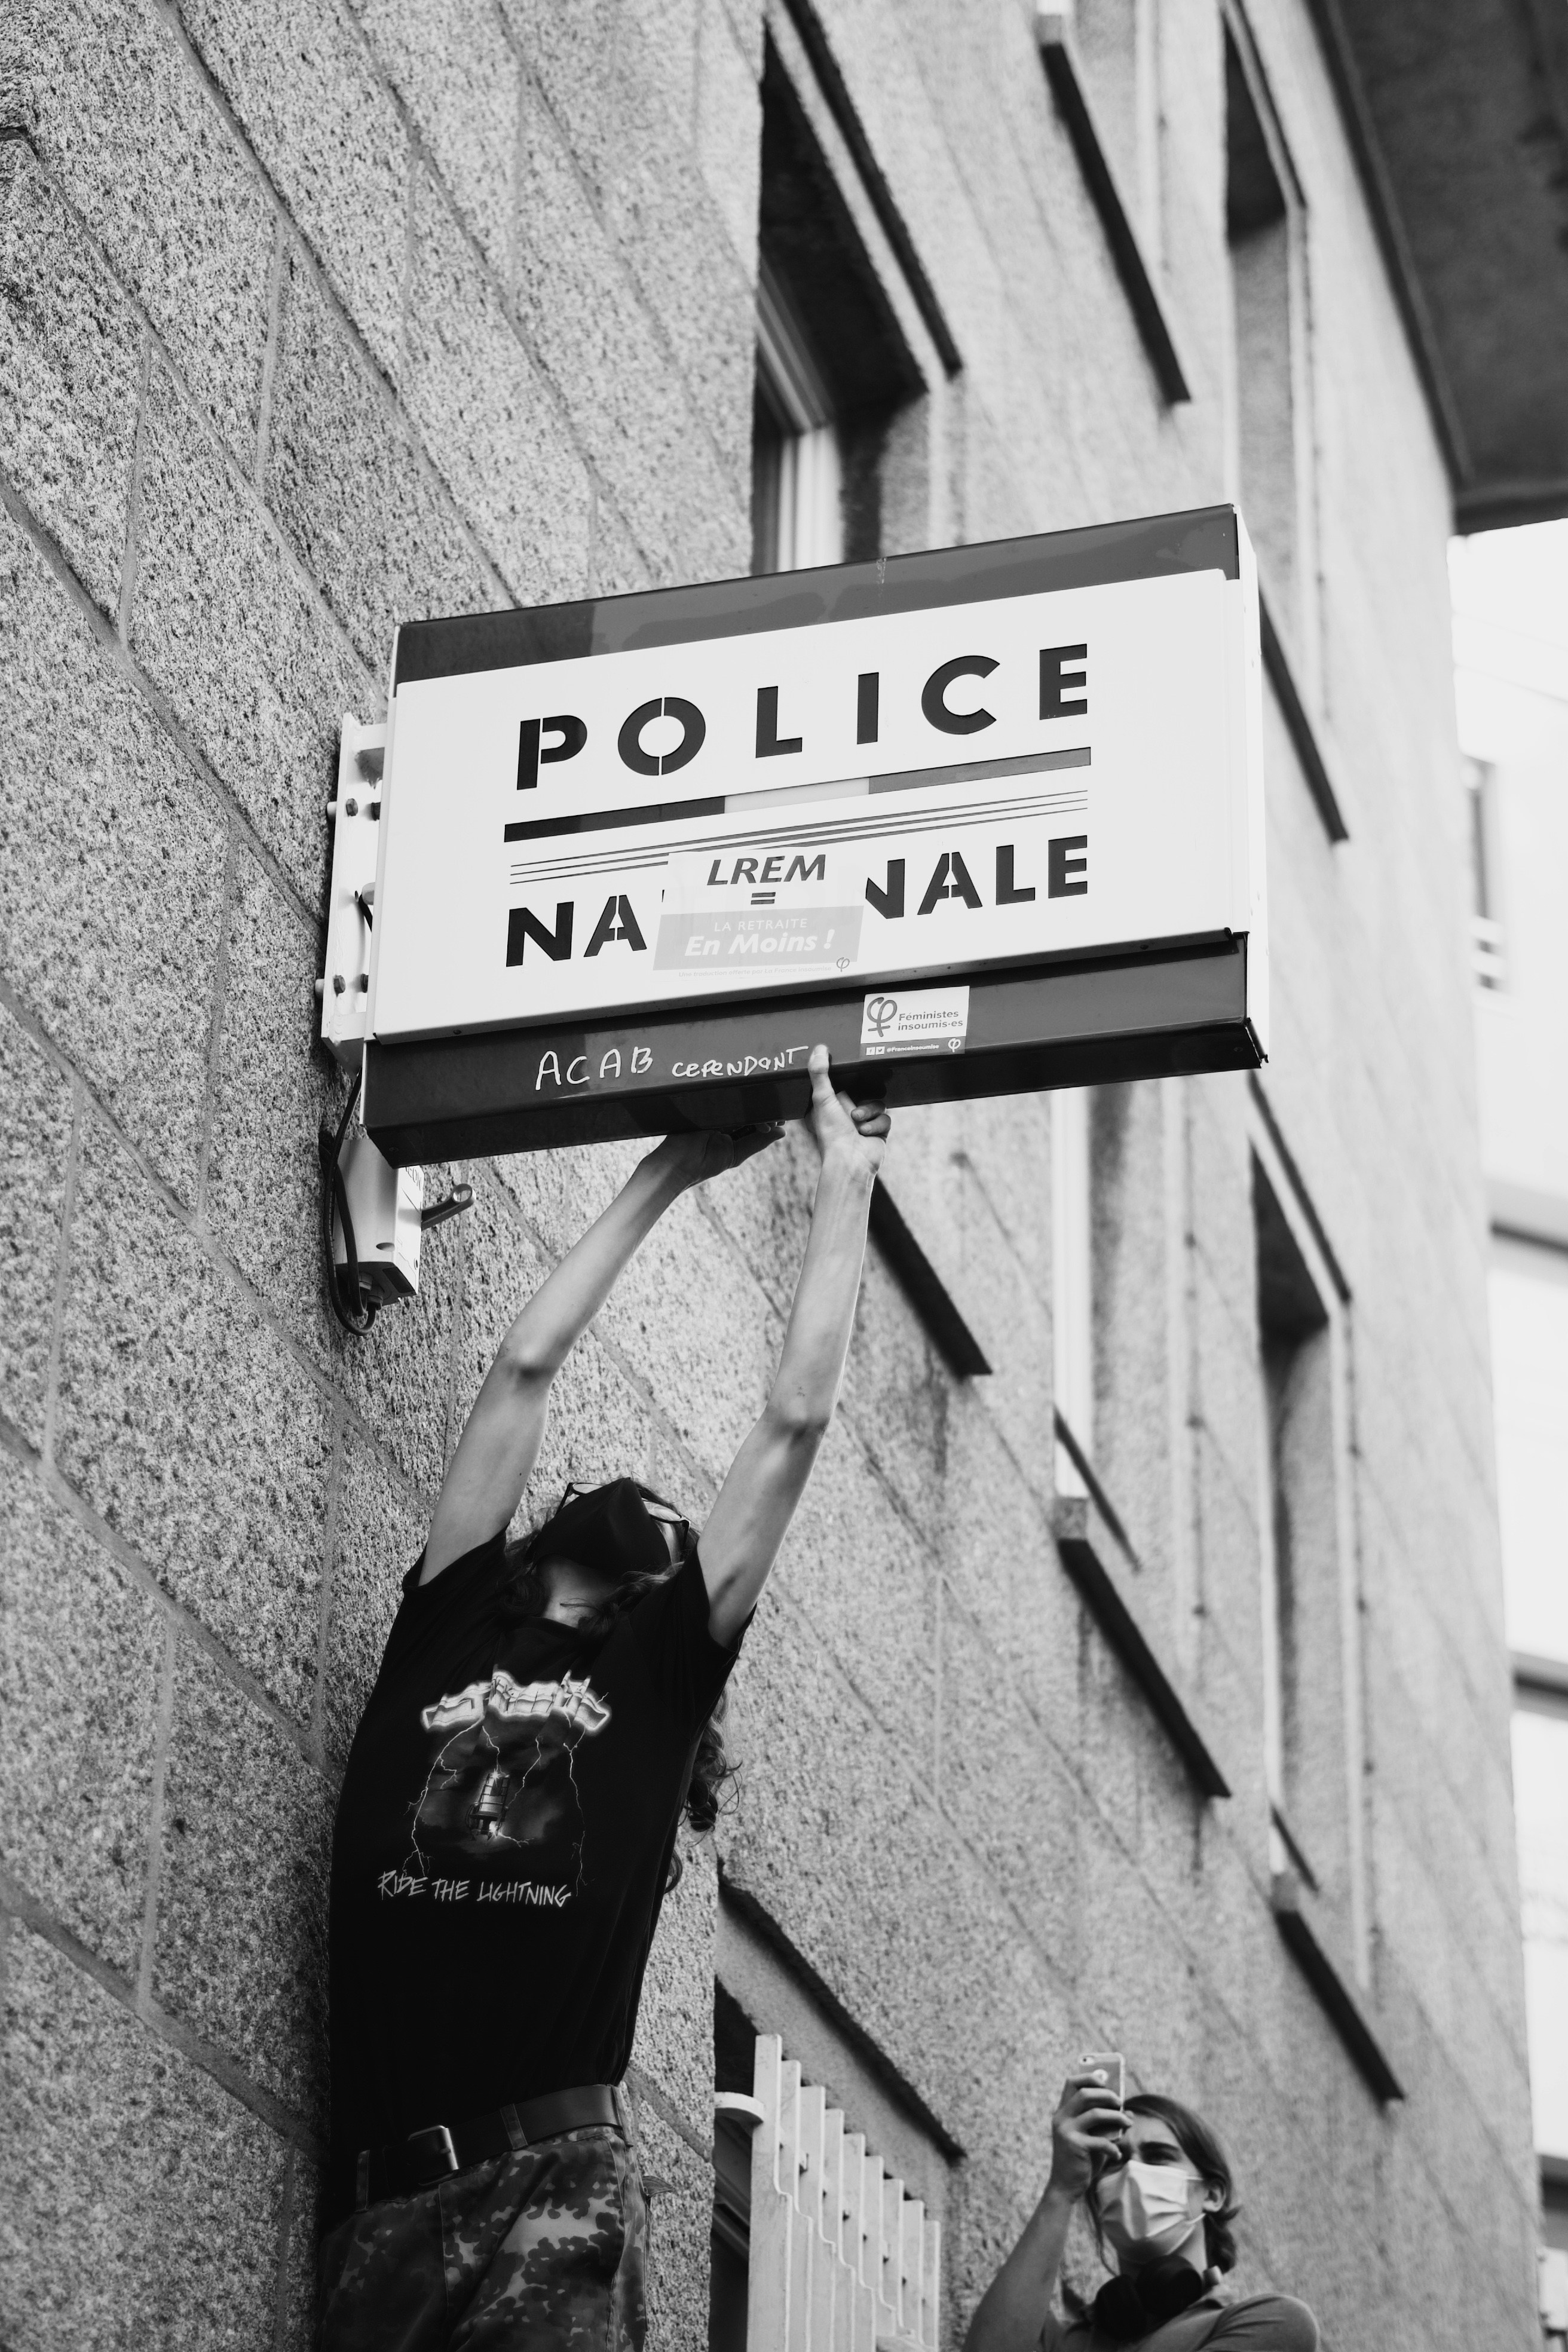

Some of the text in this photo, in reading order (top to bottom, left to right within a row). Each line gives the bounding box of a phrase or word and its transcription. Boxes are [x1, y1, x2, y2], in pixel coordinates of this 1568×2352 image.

[517, 644, 1088, 791] POLICE
[706, 854, 826, 886] LREM
[506, 835, 1088, 967] NANALE
[714, 918, 808, 932] LA RETRAITE
[684, 936, 721, 956] En
[728, 932, 817, 955] Moins
[899, 1010, 959, 1021] Féministes
[535, 1046, 653, 1090] ACAB
[378, 1870, 572, 1907] RIDE THE LIGHTNING
